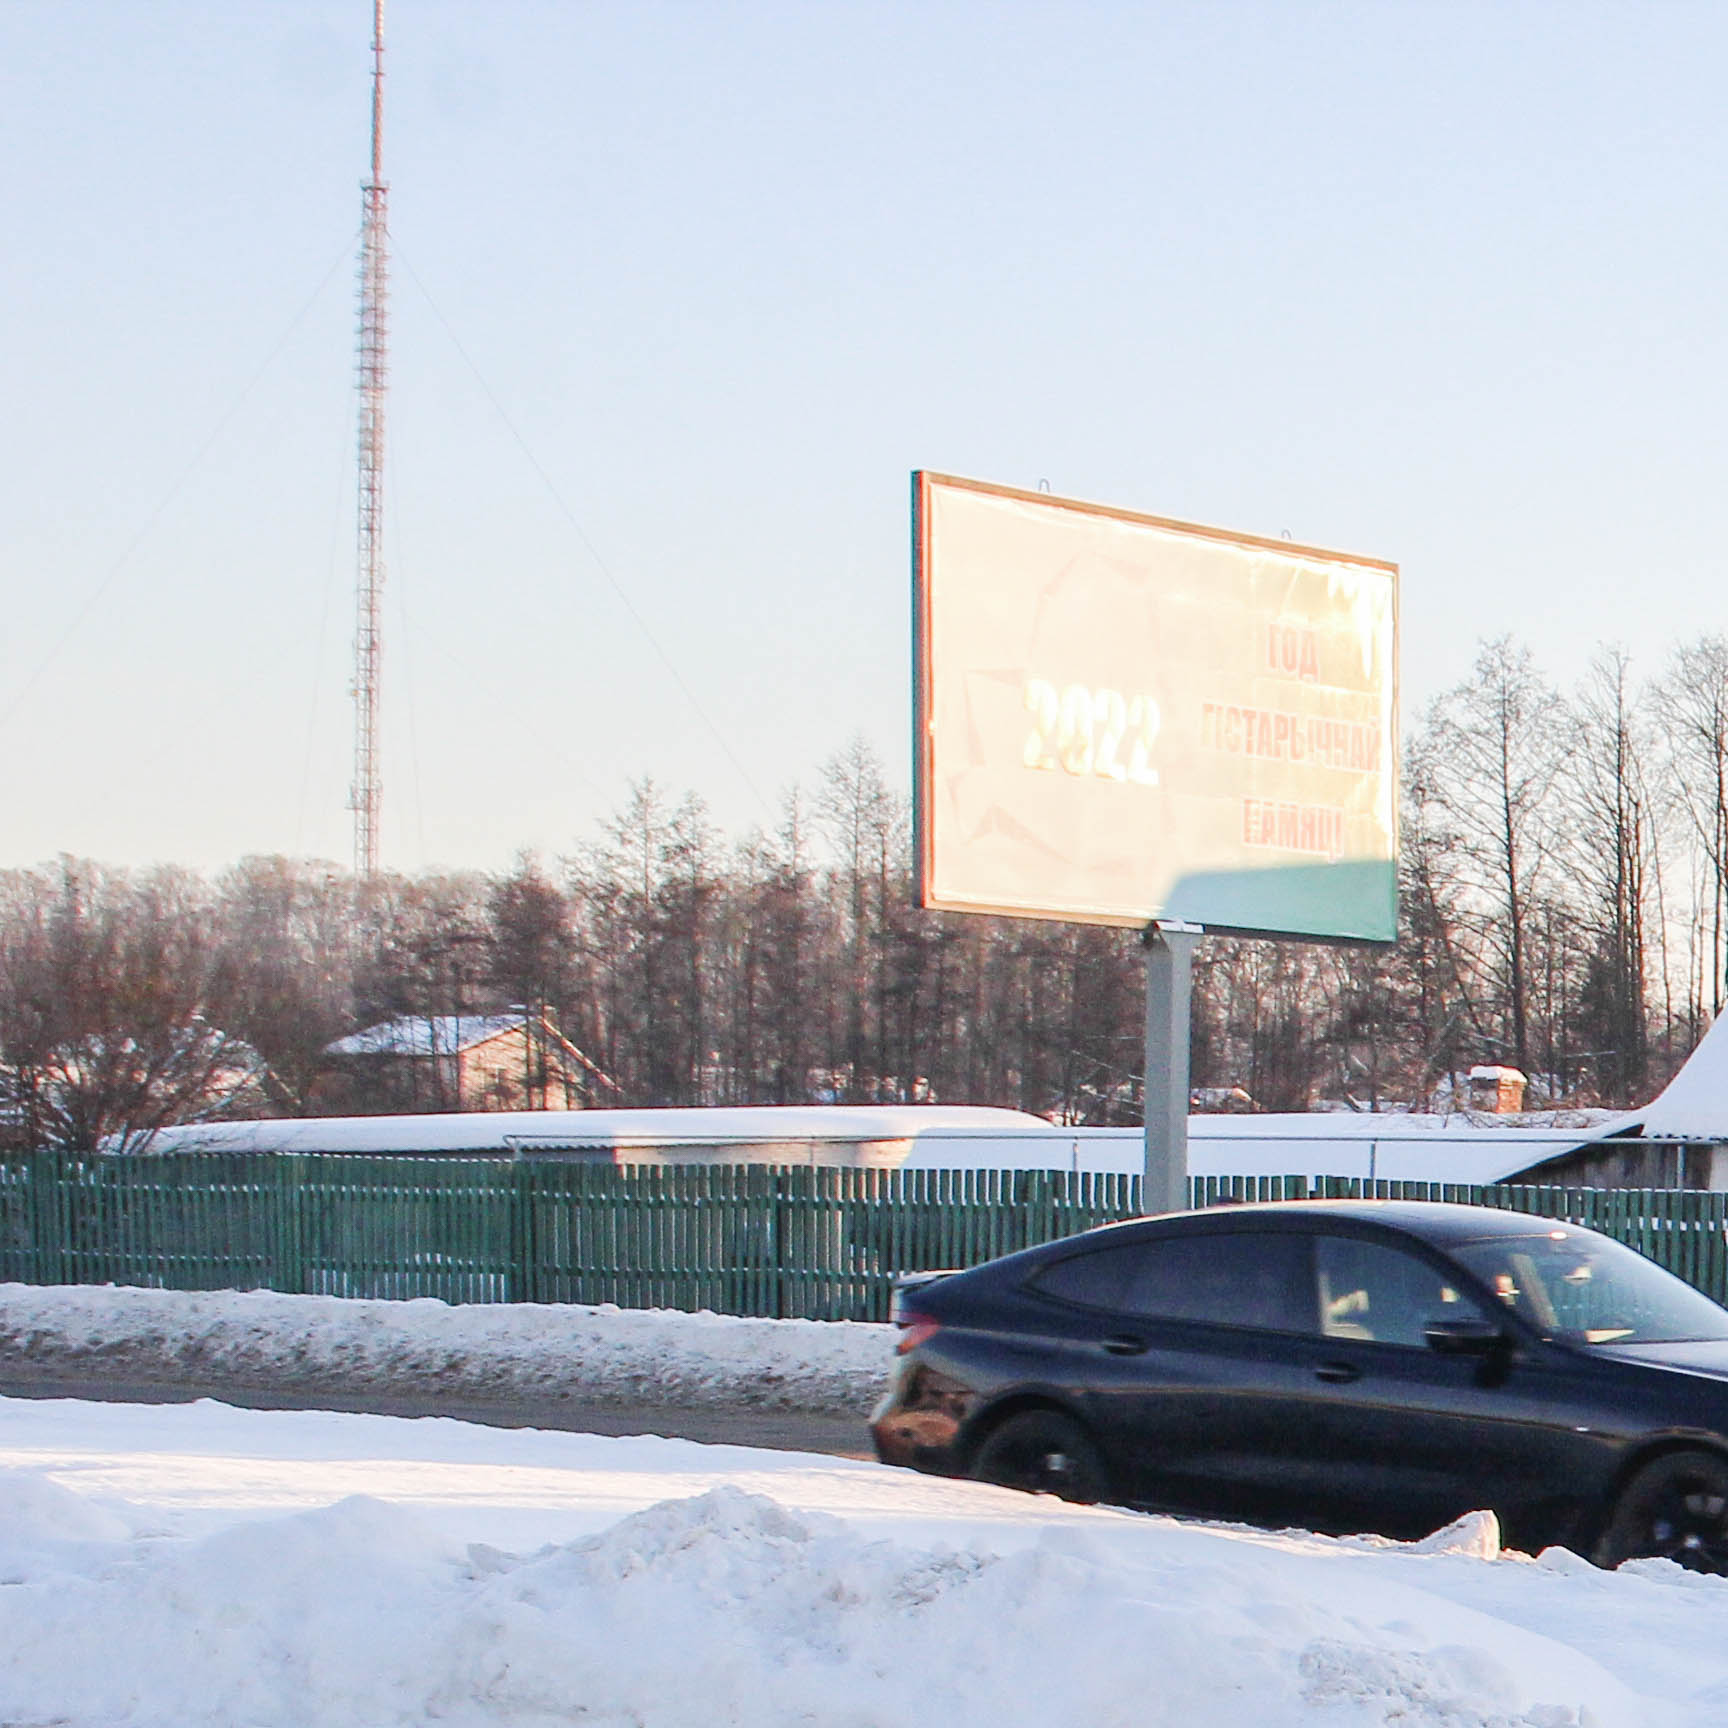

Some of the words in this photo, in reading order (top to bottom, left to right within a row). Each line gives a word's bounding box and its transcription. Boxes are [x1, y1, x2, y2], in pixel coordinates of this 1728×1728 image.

[1267, 623, 1319, 681] ГОД
[1024, 677, 1160, 787] 2022
[1202, 702, 1381, 771] ГІСТАРЫЧНАЙ
